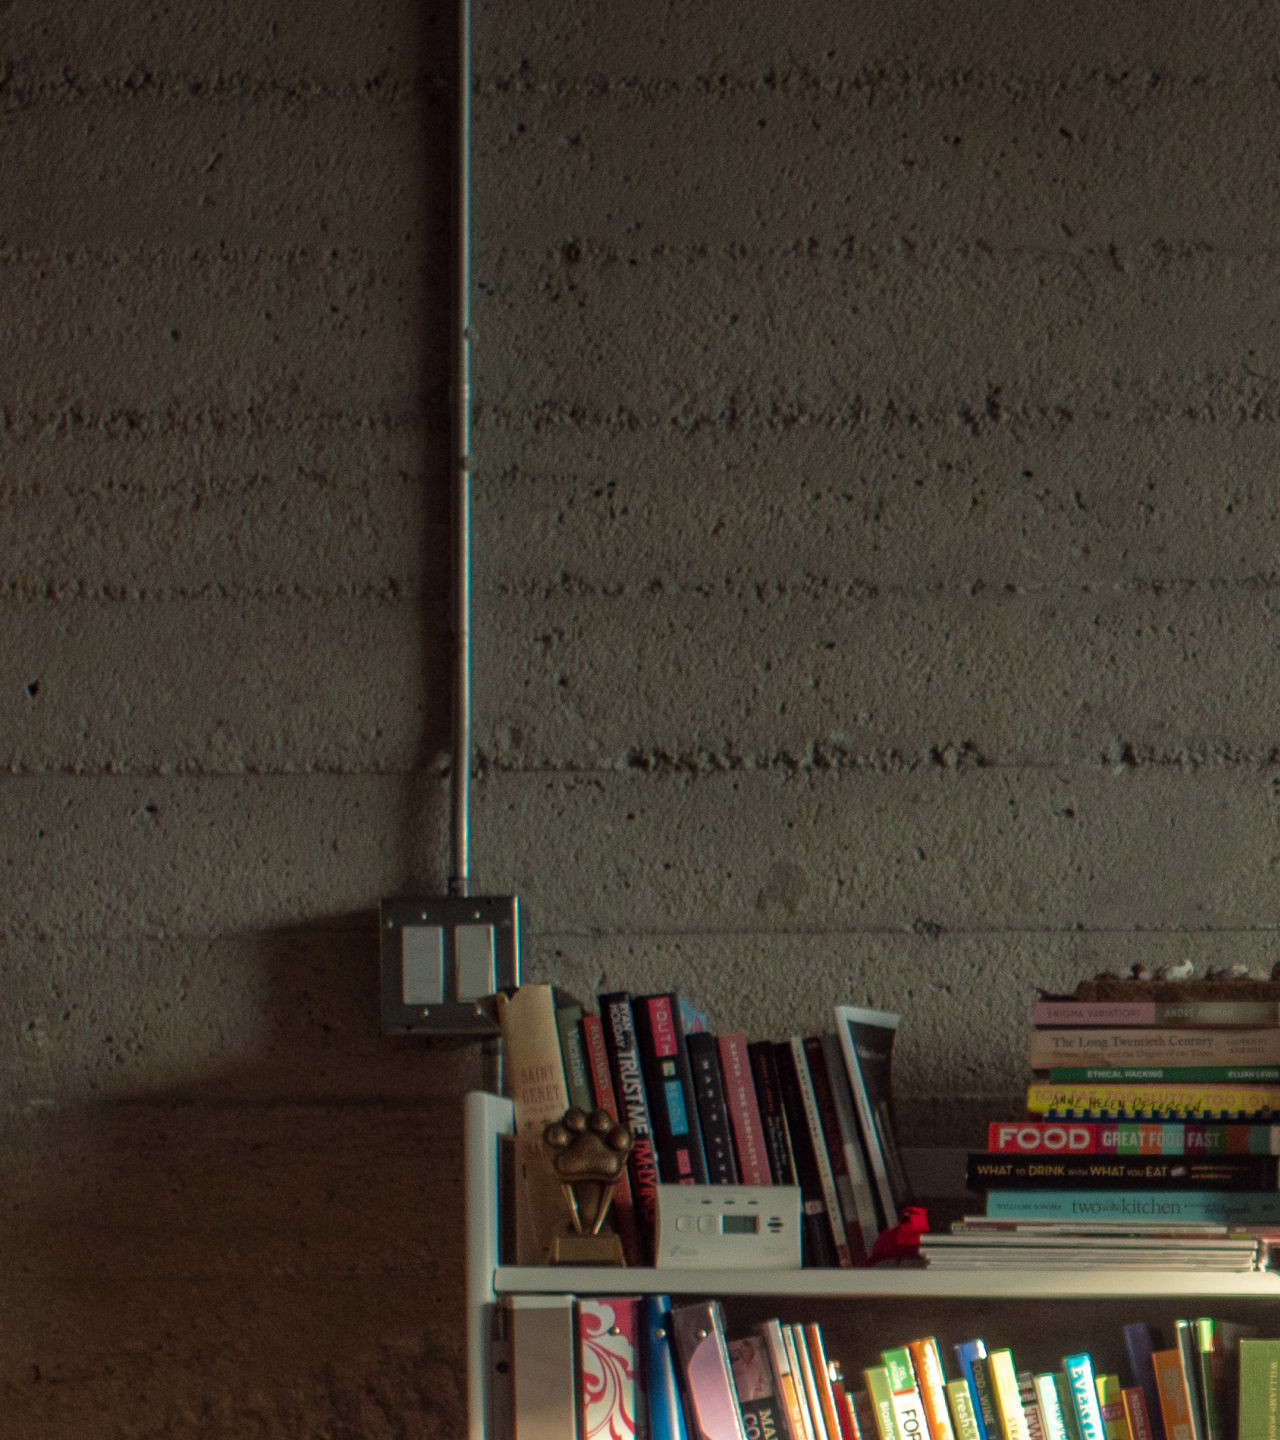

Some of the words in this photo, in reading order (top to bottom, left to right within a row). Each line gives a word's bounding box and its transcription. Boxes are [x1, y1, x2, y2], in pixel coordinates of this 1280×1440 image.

[655, 1000, 677, 1056] YOUTH
[565, 1028, 586, 1088] Vacation
[617, 1049, 643, 1106] TRUST
[1087, 1070, 1123, 1078] ETHICAL
[1125, 1070, 1163, 1079] HACKING
[666, 1082, 686, 1133] REVOLT
[1089, 1095, 1125, 1110] HELEN
[1132, 1099, 1203, 1113] PETERSEN
[628, 1105, 648, 1137] ME
[1000, 1128, 1091, 1149] FOOD
[1103, 1131, 1149, 1148] GREAT
[1150, 1131, 1186, 1148] FOOD
[1188, 1131, 1222, 1148] FAST
[979, 1165, 1014, 1177] WHAT
[1030, 1165, 1066, 1177] DRINK
[1091, 1165, 1127, 1177] WHAT
[1146, 1165, 1169, 1177] EAT
[1073, 1200, 1103, 1215] two
[1122, 1198, 1182, 1215] kitchen
